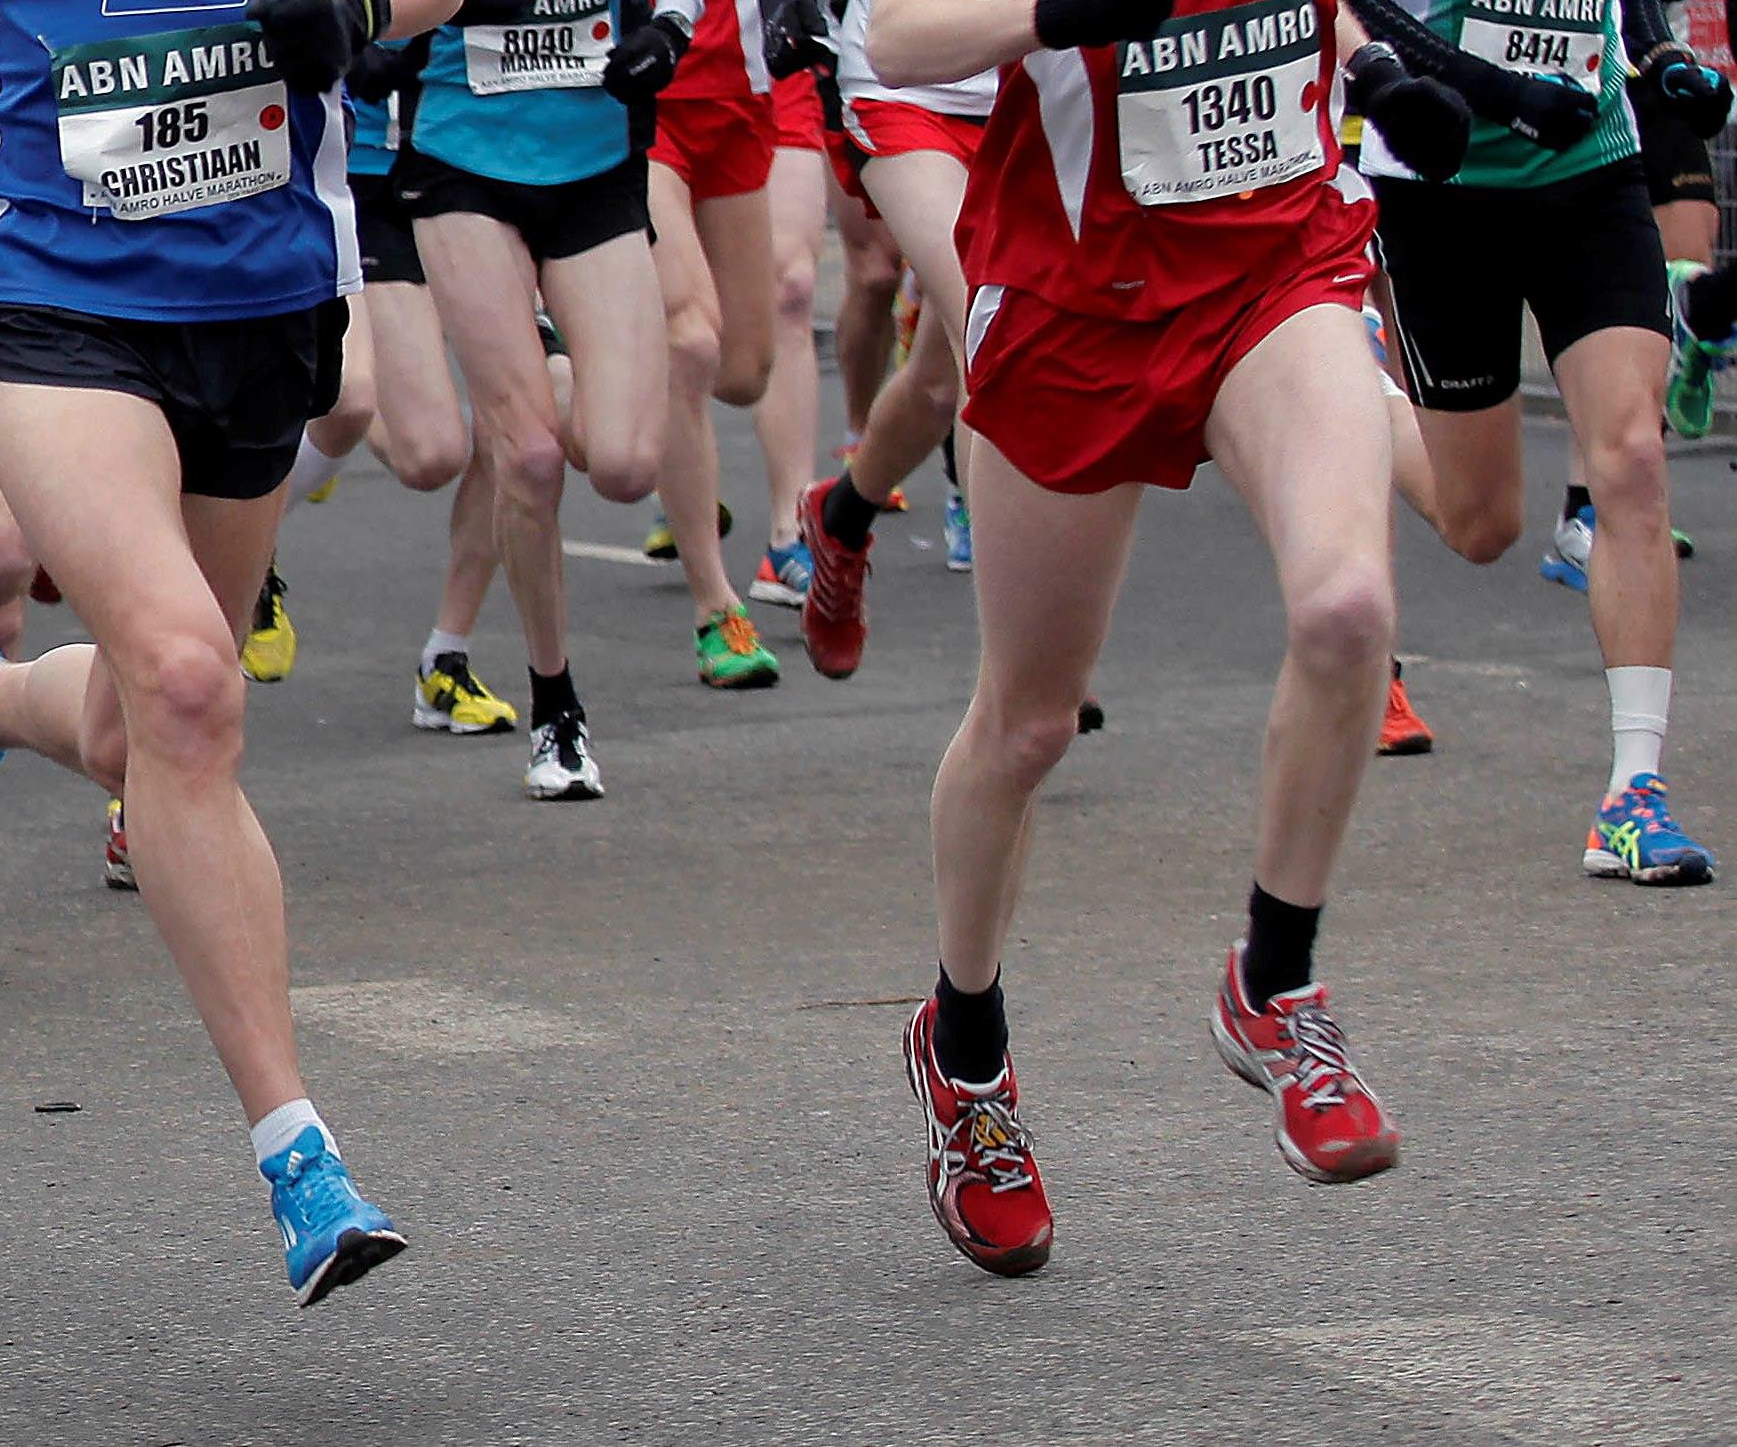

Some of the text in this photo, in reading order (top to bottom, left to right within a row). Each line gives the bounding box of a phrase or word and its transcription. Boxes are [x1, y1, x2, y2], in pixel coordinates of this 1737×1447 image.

[503, 25, 574, 55] 8040
[1121, 3, 1317, 78] ABN AMRO
[1504, 29, 1570, 68] 8414
[59, 54, 149, 100] ABN
[135, 101, 209, 154] 185
[1180, 74, 1277, 136] 1340
[100, 139, 262, 200] CHRISTIAAN
[1197, 129, 1278, 174] TESSA
[118, 172, 275, 214] AMRO HALVE MARATHON
[1175, 177, 1216, 194] AMRO
[1217, 167, 1258, 188] HALVE
